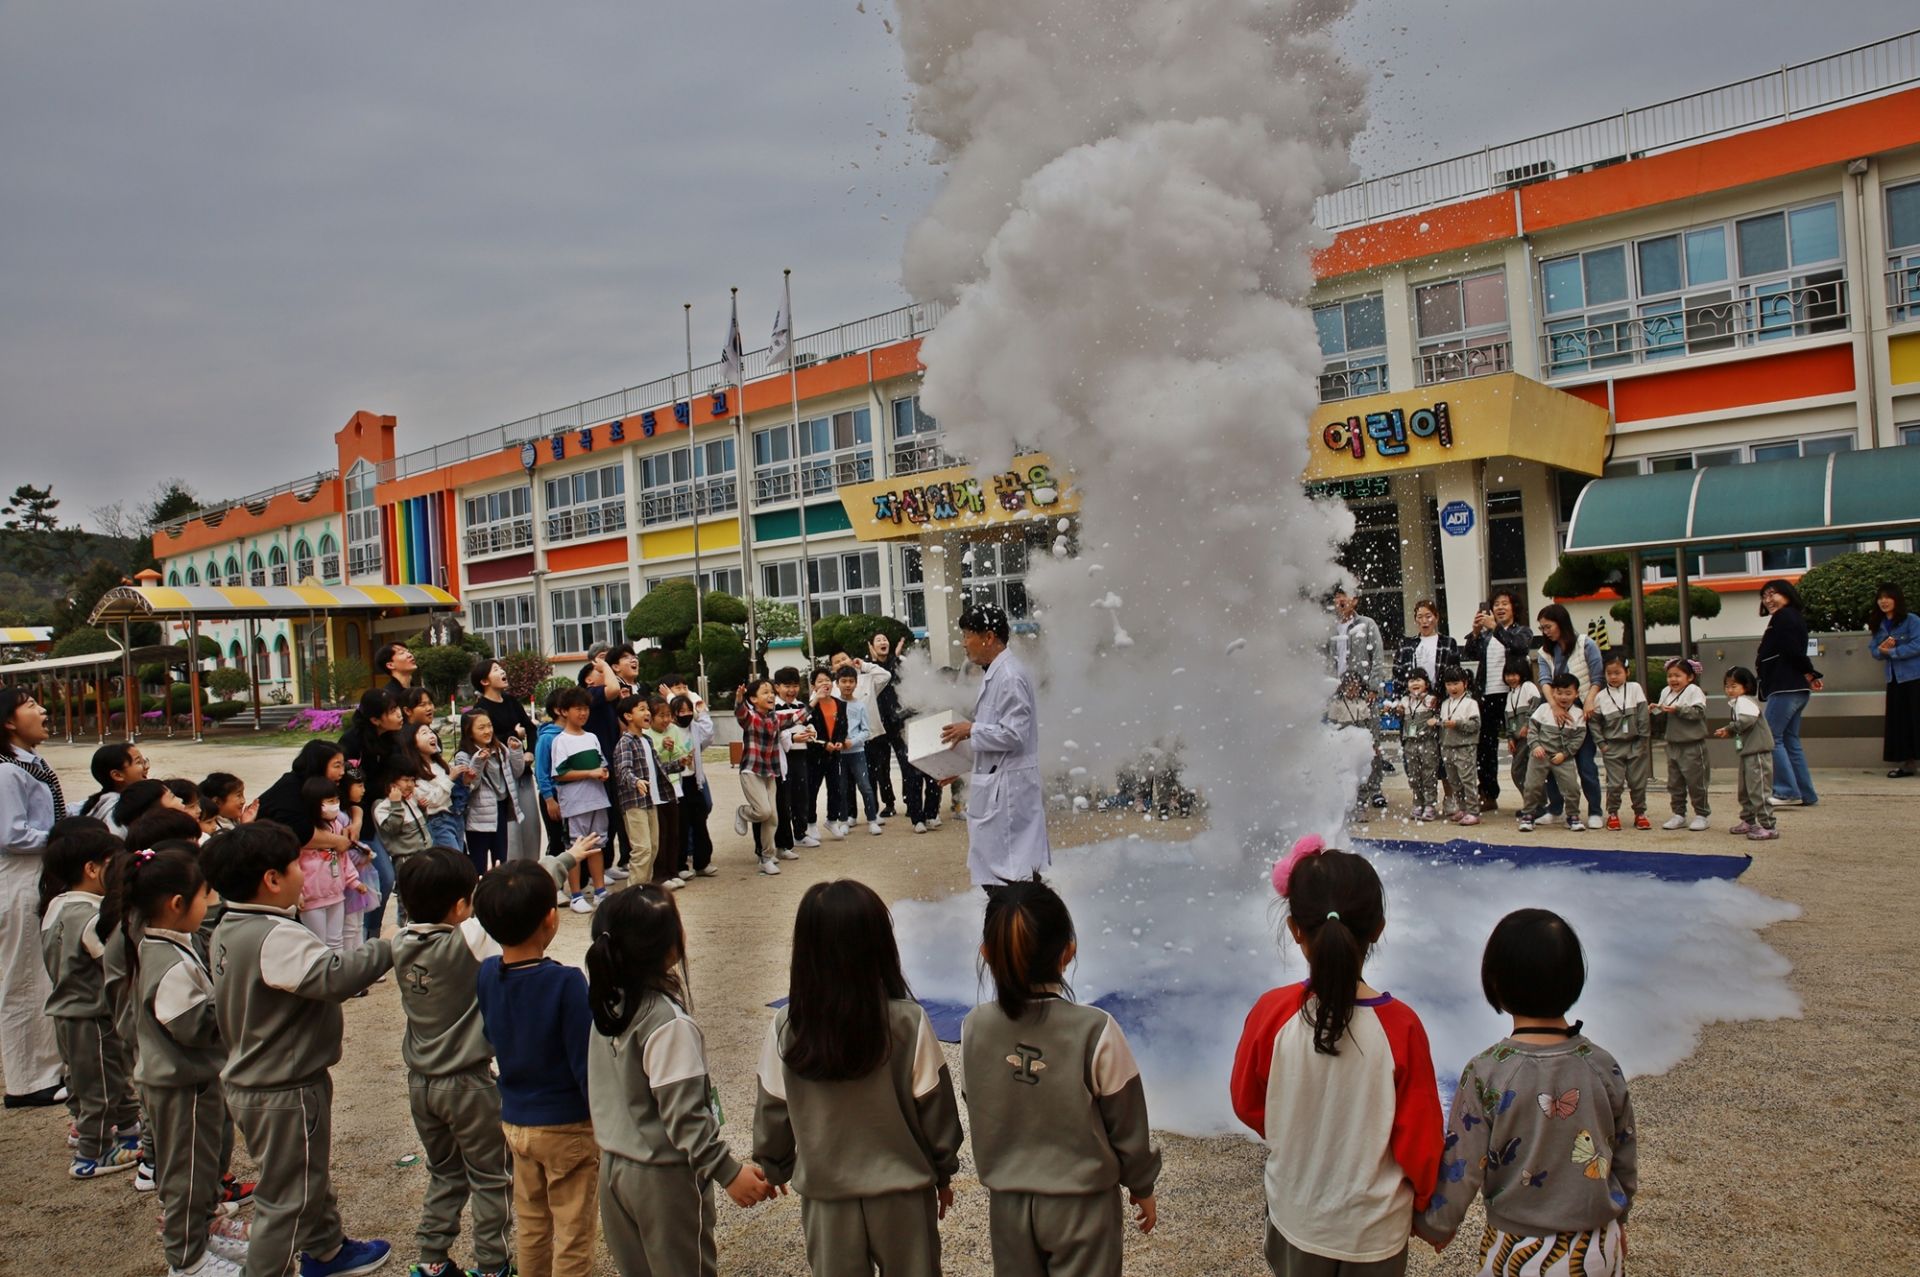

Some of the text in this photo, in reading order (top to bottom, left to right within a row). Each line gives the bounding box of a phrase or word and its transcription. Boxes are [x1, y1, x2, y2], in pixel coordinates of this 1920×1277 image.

[1323, 402, 1453, 459] 어린이
[873, 478, 985, 524] 자신있게
[1446, 511, 1469, 525] ADT
